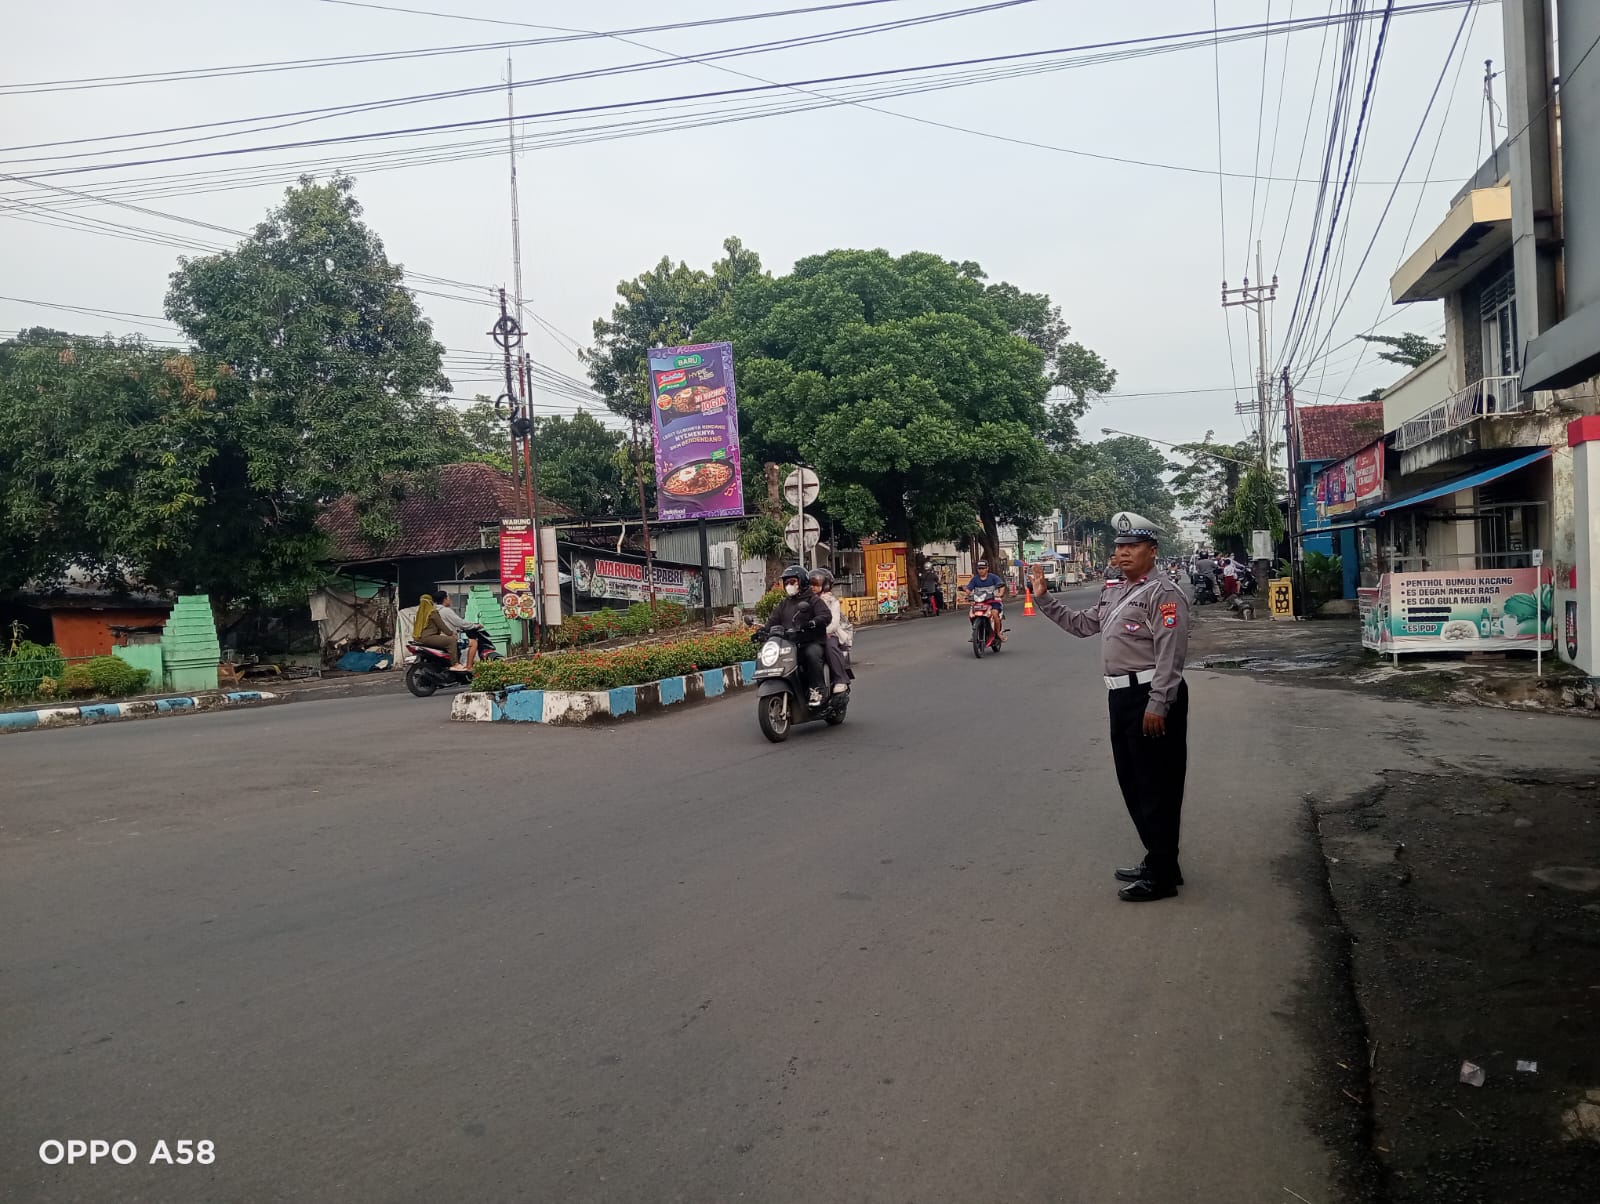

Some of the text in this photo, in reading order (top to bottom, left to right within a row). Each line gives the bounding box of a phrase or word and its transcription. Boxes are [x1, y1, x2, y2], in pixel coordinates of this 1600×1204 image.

[677, 357, 698, 367] BARU
[701, 396, 727, 412] JOGJA
[502, 518, 531, 526] WARUNG
[595, 559, 684, 585] WARUNG PEPABRI
[1406, 577, 1513, 588] PENTHOL BUMBU KACANG
[1406, 586, 1500, 597] ES DEGAN ANEKA RASA
[1406, 596, 1491, 606] ES CAO GULA MERAH
[1407, 624, 1437, 632] ES POP
